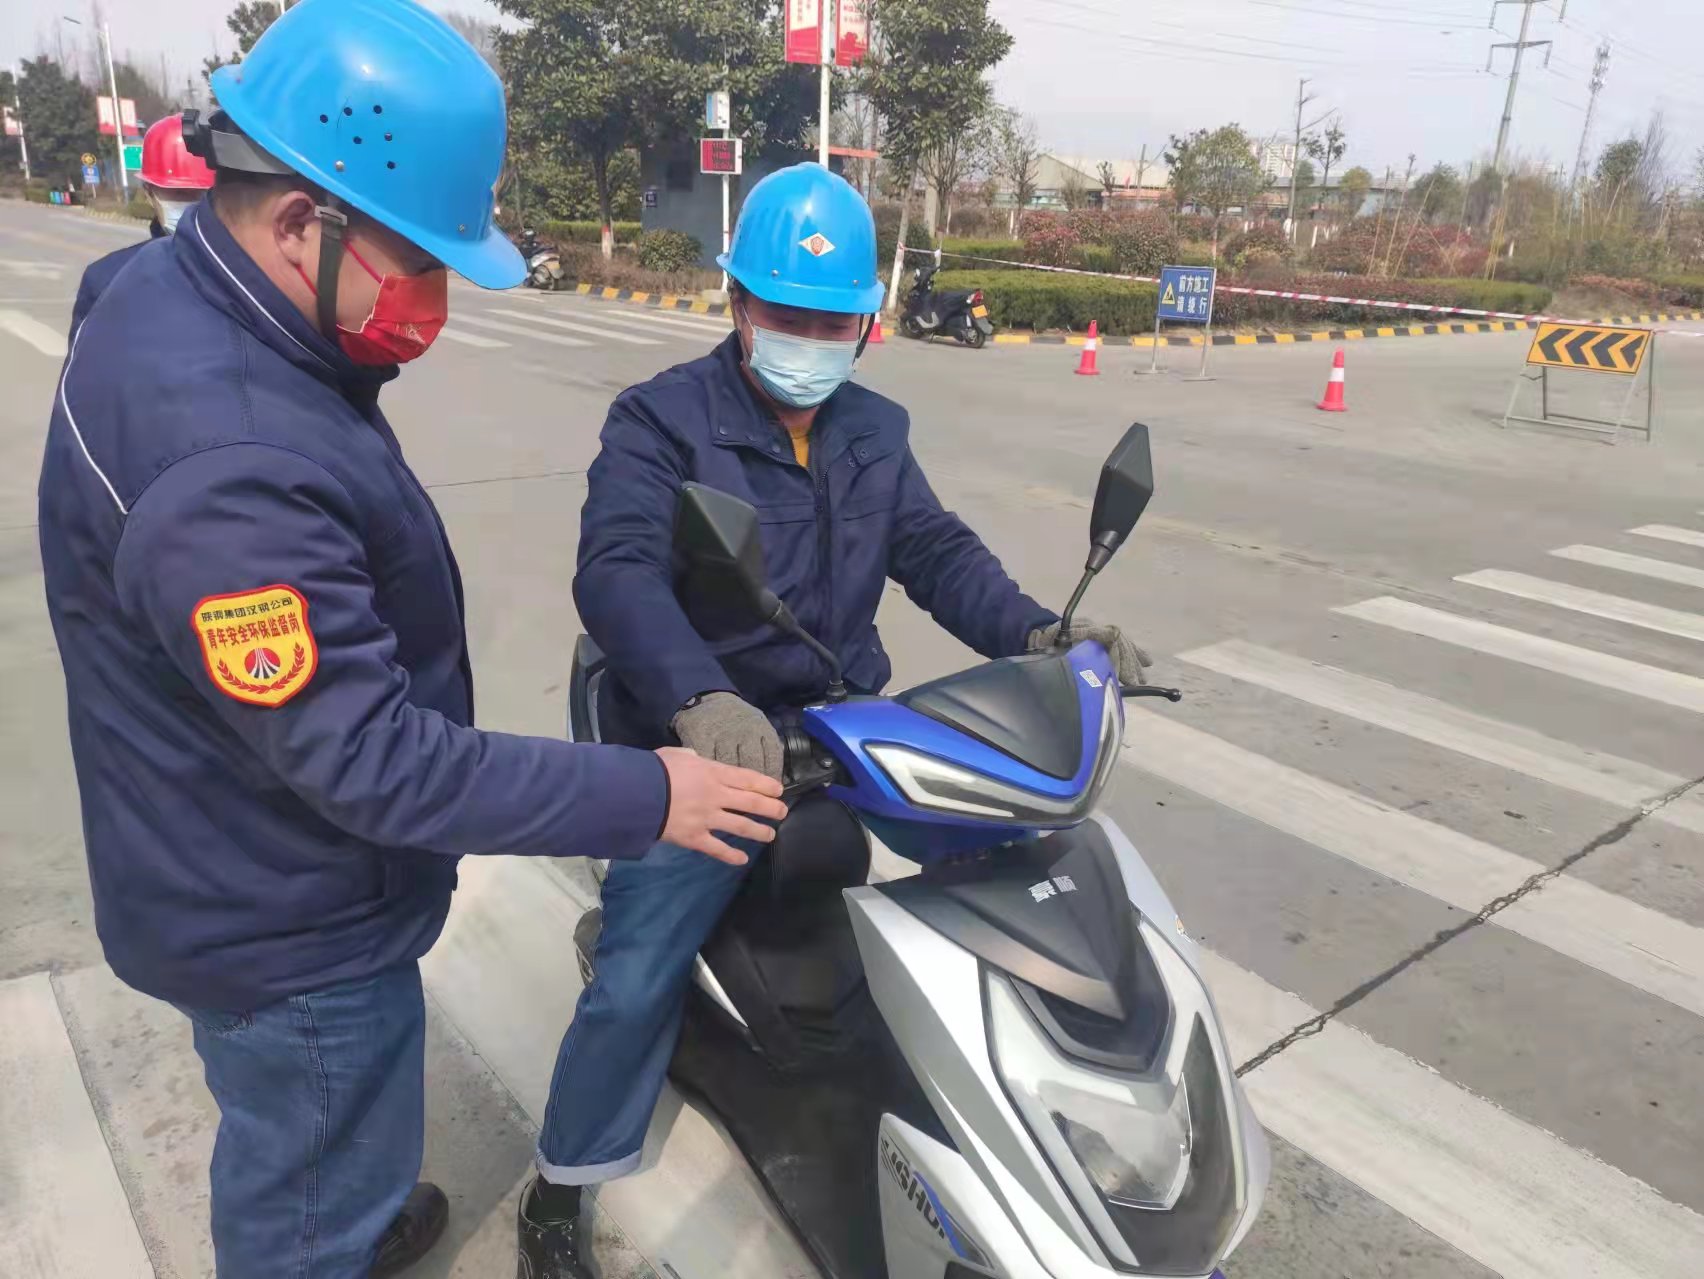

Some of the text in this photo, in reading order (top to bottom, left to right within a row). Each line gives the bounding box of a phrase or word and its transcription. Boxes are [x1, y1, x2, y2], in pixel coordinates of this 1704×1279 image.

[1178, 274, 1209, 293] 前方施工
[201, 597, 293, 622] 陕钢集团汉钢公司
[207, 612, 300, 649] 青年安全环保监督岗
